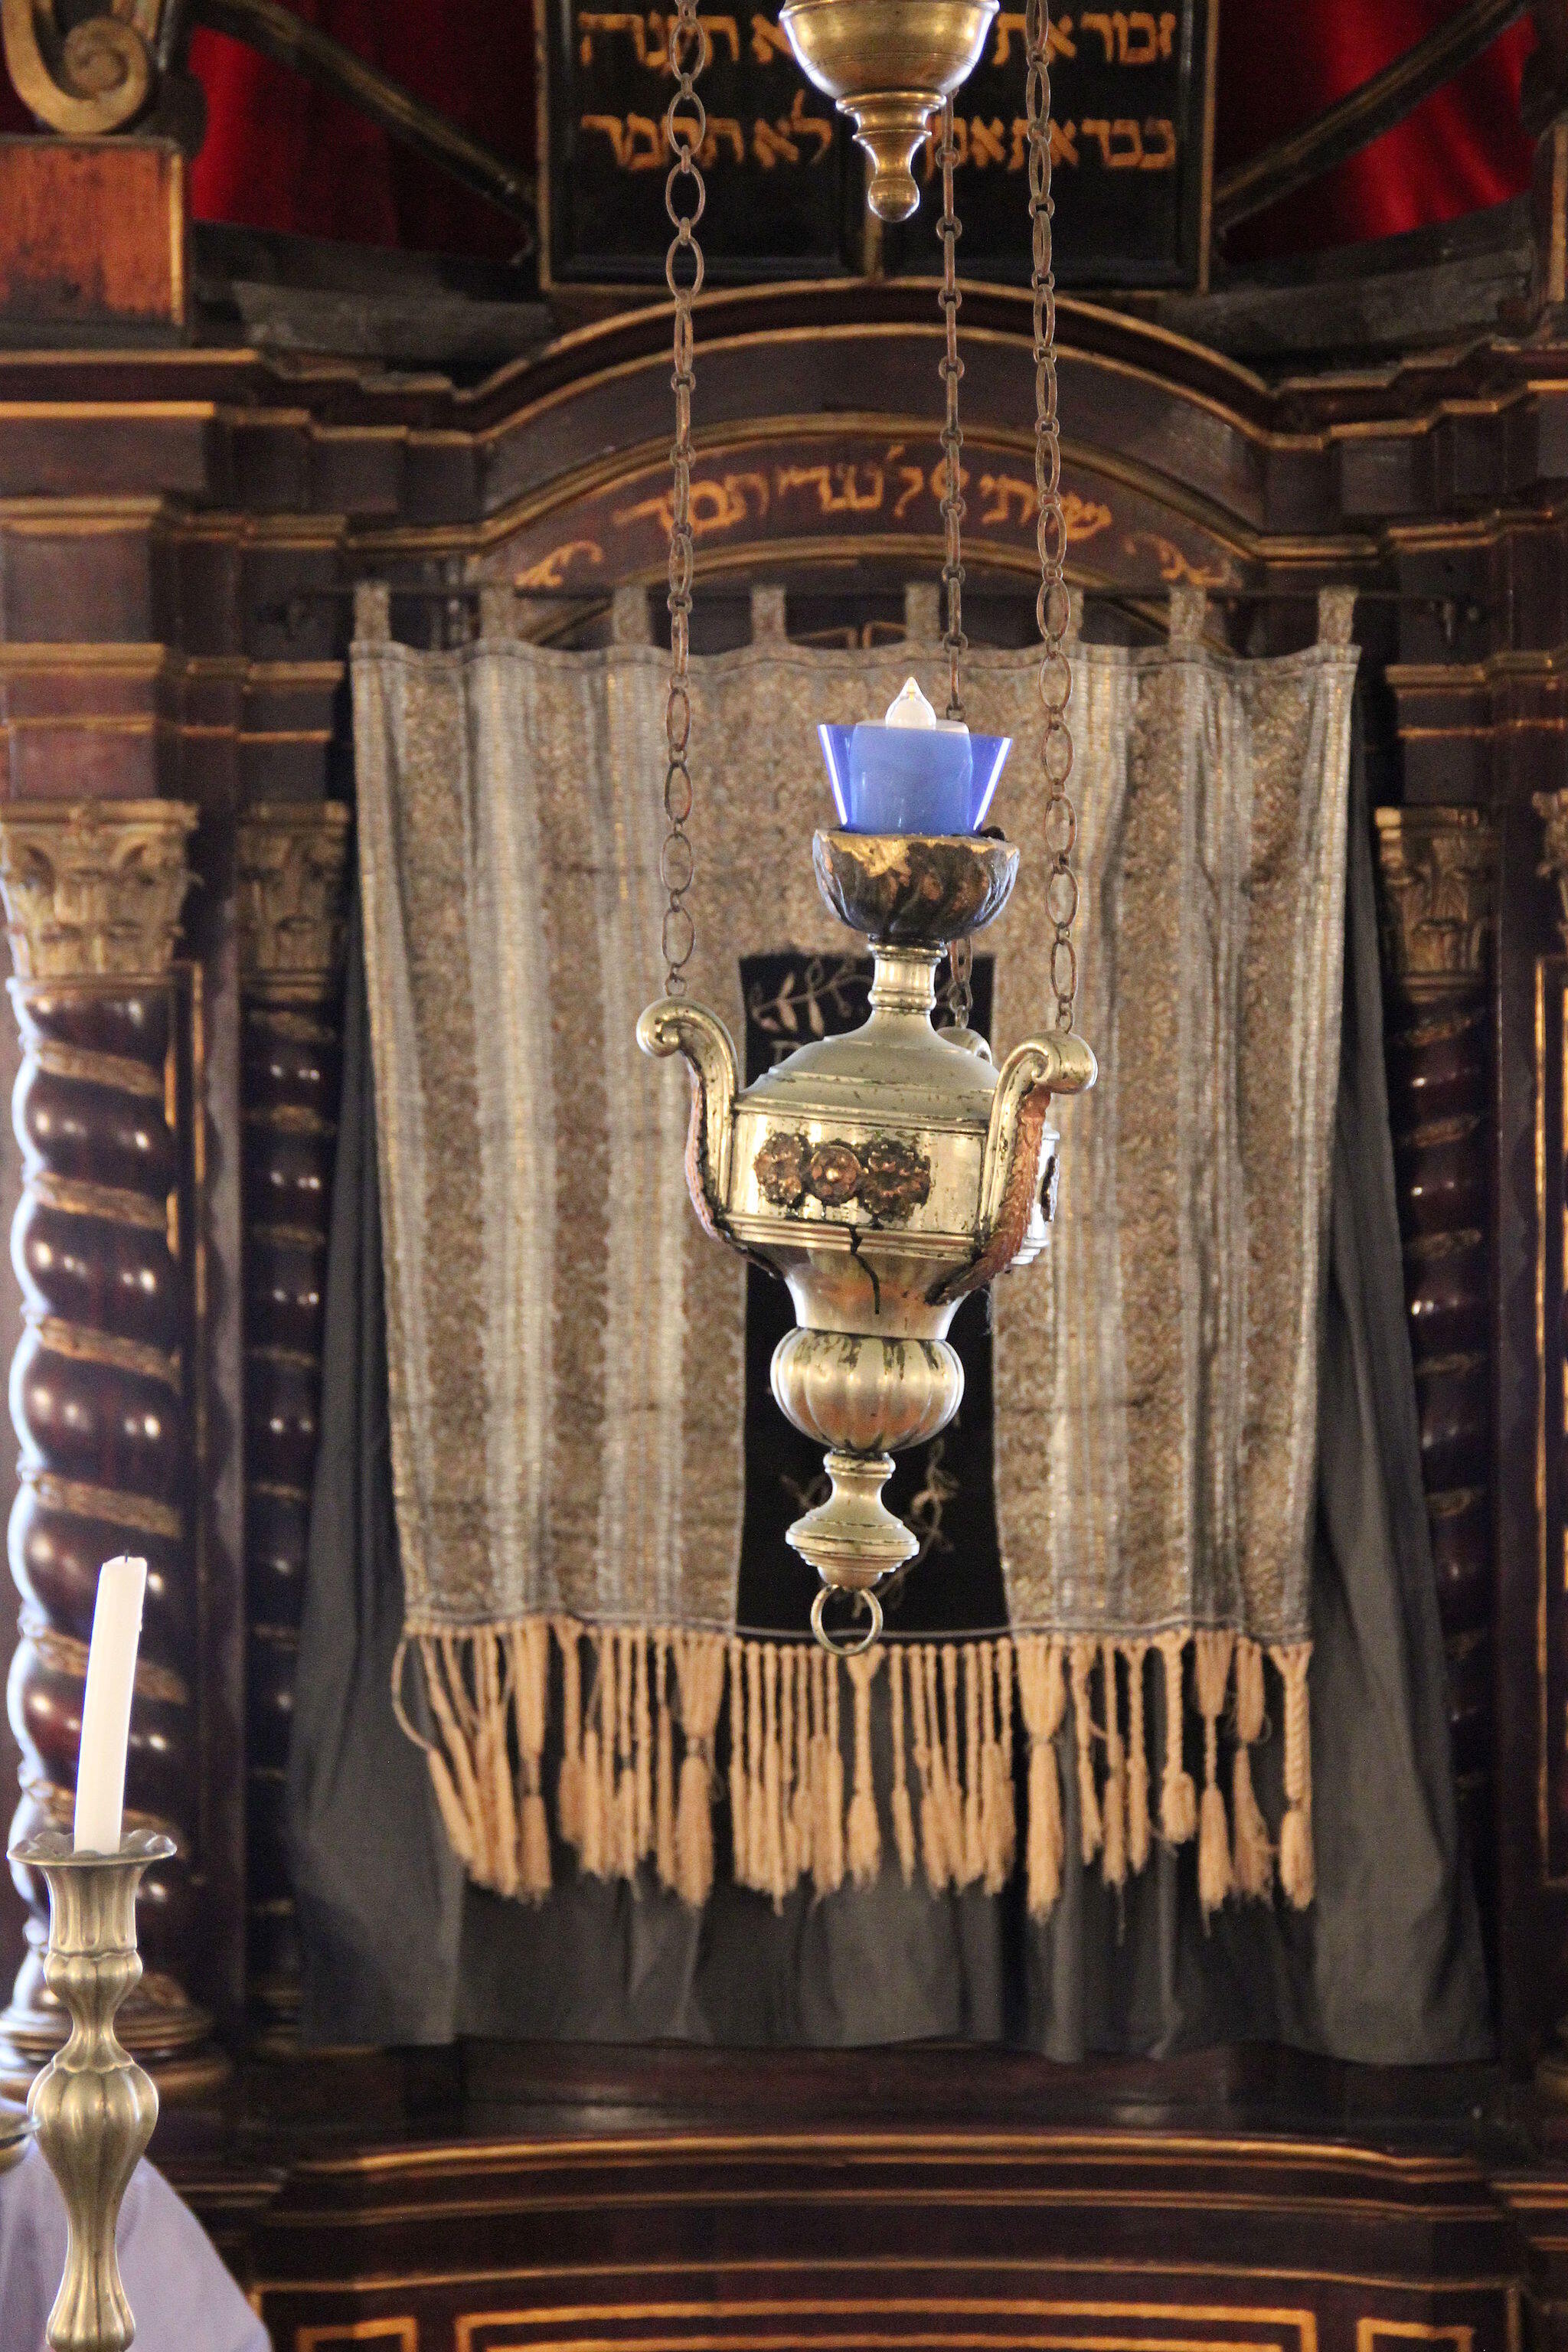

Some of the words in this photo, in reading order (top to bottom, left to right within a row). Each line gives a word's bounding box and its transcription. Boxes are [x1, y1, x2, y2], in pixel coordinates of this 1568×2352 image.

[751, 13, 796, 64] א
[993, 12, 1076, 66] את
[580, 113, 744, 170] תחמד
[753, 89, 832, 168] לא
[1081, 119, 1176, 169] כבד
